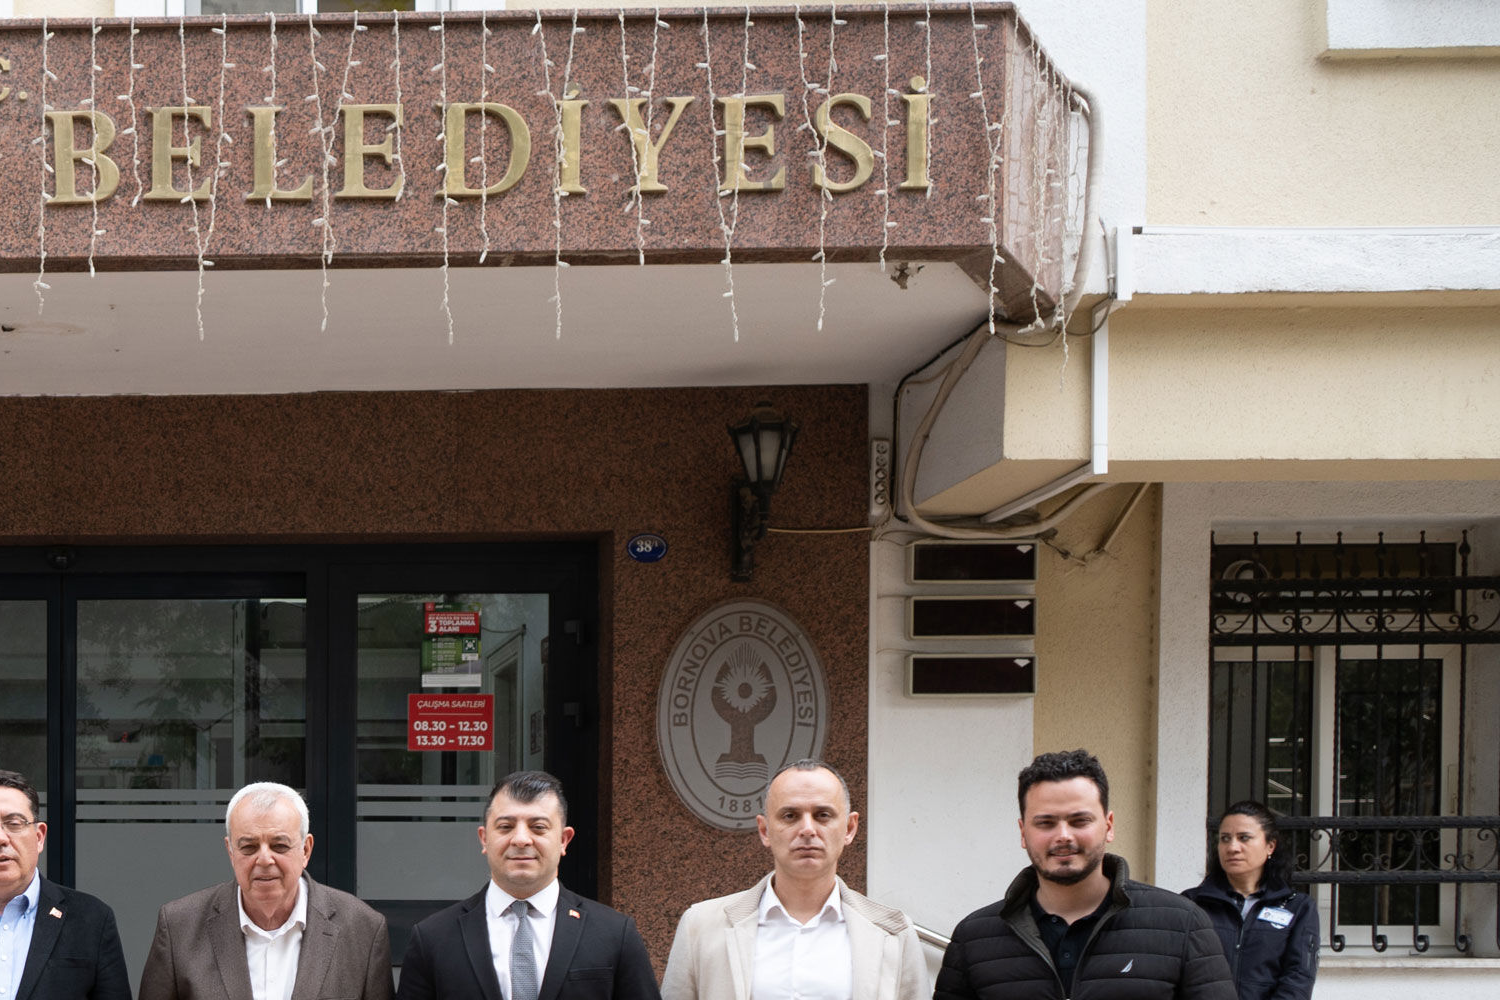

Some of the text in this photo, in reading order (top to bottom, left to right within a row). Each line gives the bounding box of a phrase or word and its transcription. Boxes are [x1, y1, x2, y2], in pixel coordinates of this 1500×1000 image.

[45, 75, 936, 207] BELEDİYESİ
[428, 620, 437, 633] 3
[673, 616, 816, 729] BORNOVA BELEDİYESİ
[417, 699, 486, 709] ÇALIŞMA SAATLERİ
[413, 721, 447, 731] 08.30
[458, 721, 488, 731] 12.30
[416, 736, 446, 746] 13.30
[457, 736, 486, 746] 17.30
